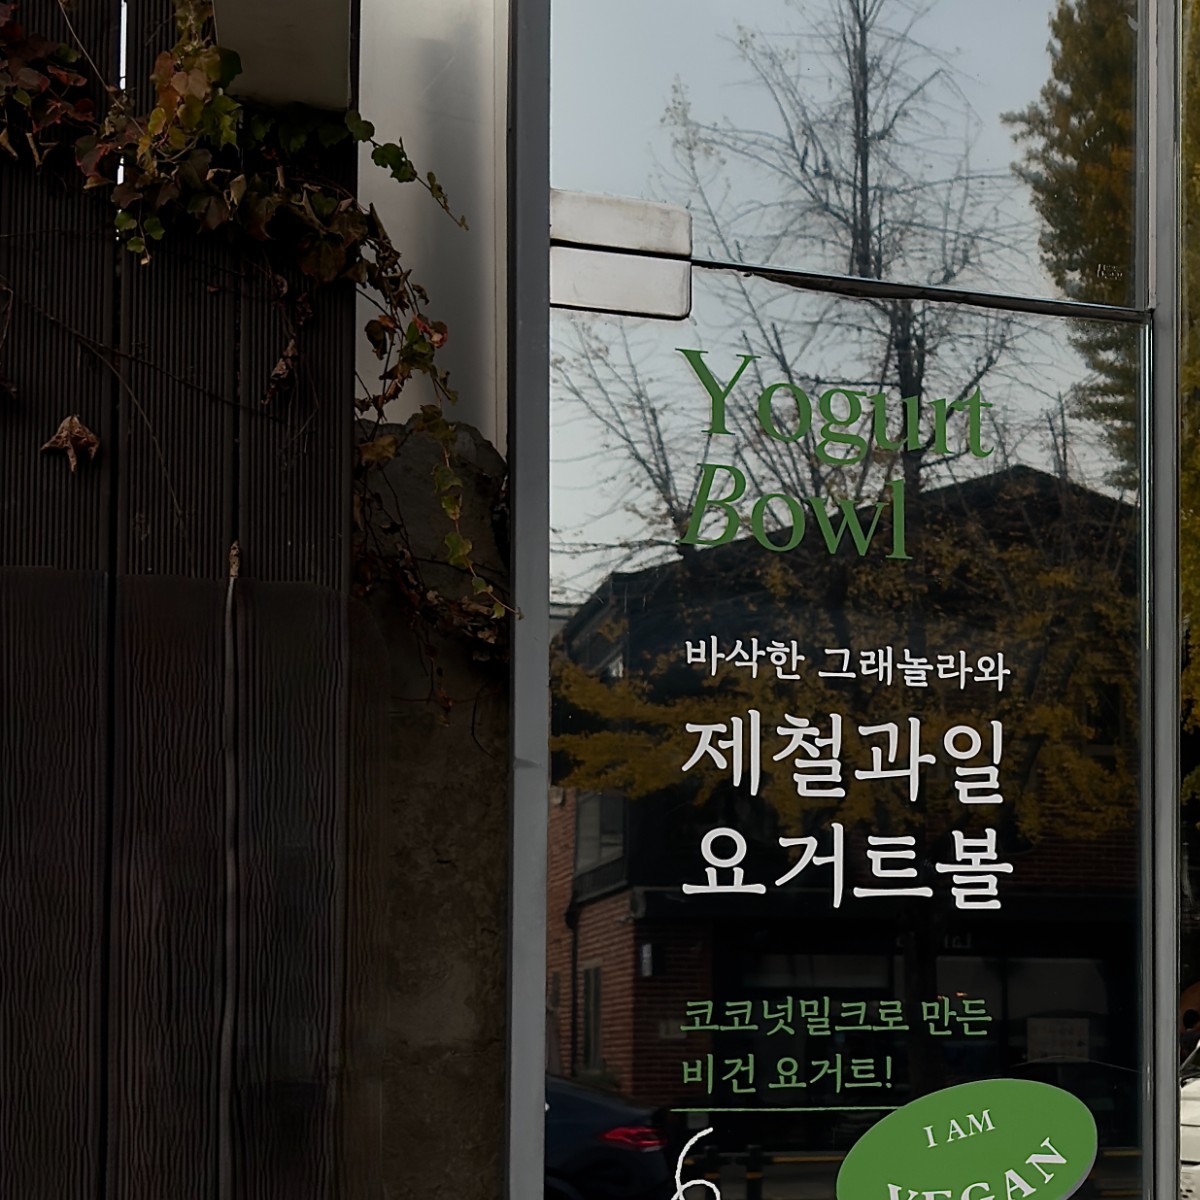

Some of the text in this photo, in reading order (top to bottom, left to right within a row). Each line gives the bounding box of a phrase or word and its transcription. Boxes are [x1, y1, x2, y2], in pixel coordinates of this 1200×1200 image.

[675, 348, 995, 465] Yogurt
[675, 463, 913, 560] Bowl
[685, 635, 1011, 692] 바삭한 그래놀라와
[681, 709, 1004, 804] 제철과일
[681, 822, 1014, 909] 요거트볼
[680, 996, 993, 1036] 코코넛밀크로 만든
[682, 1053, 893, 1094] 비건 요거트!
[923, 1109, 995, 1148] I AM
